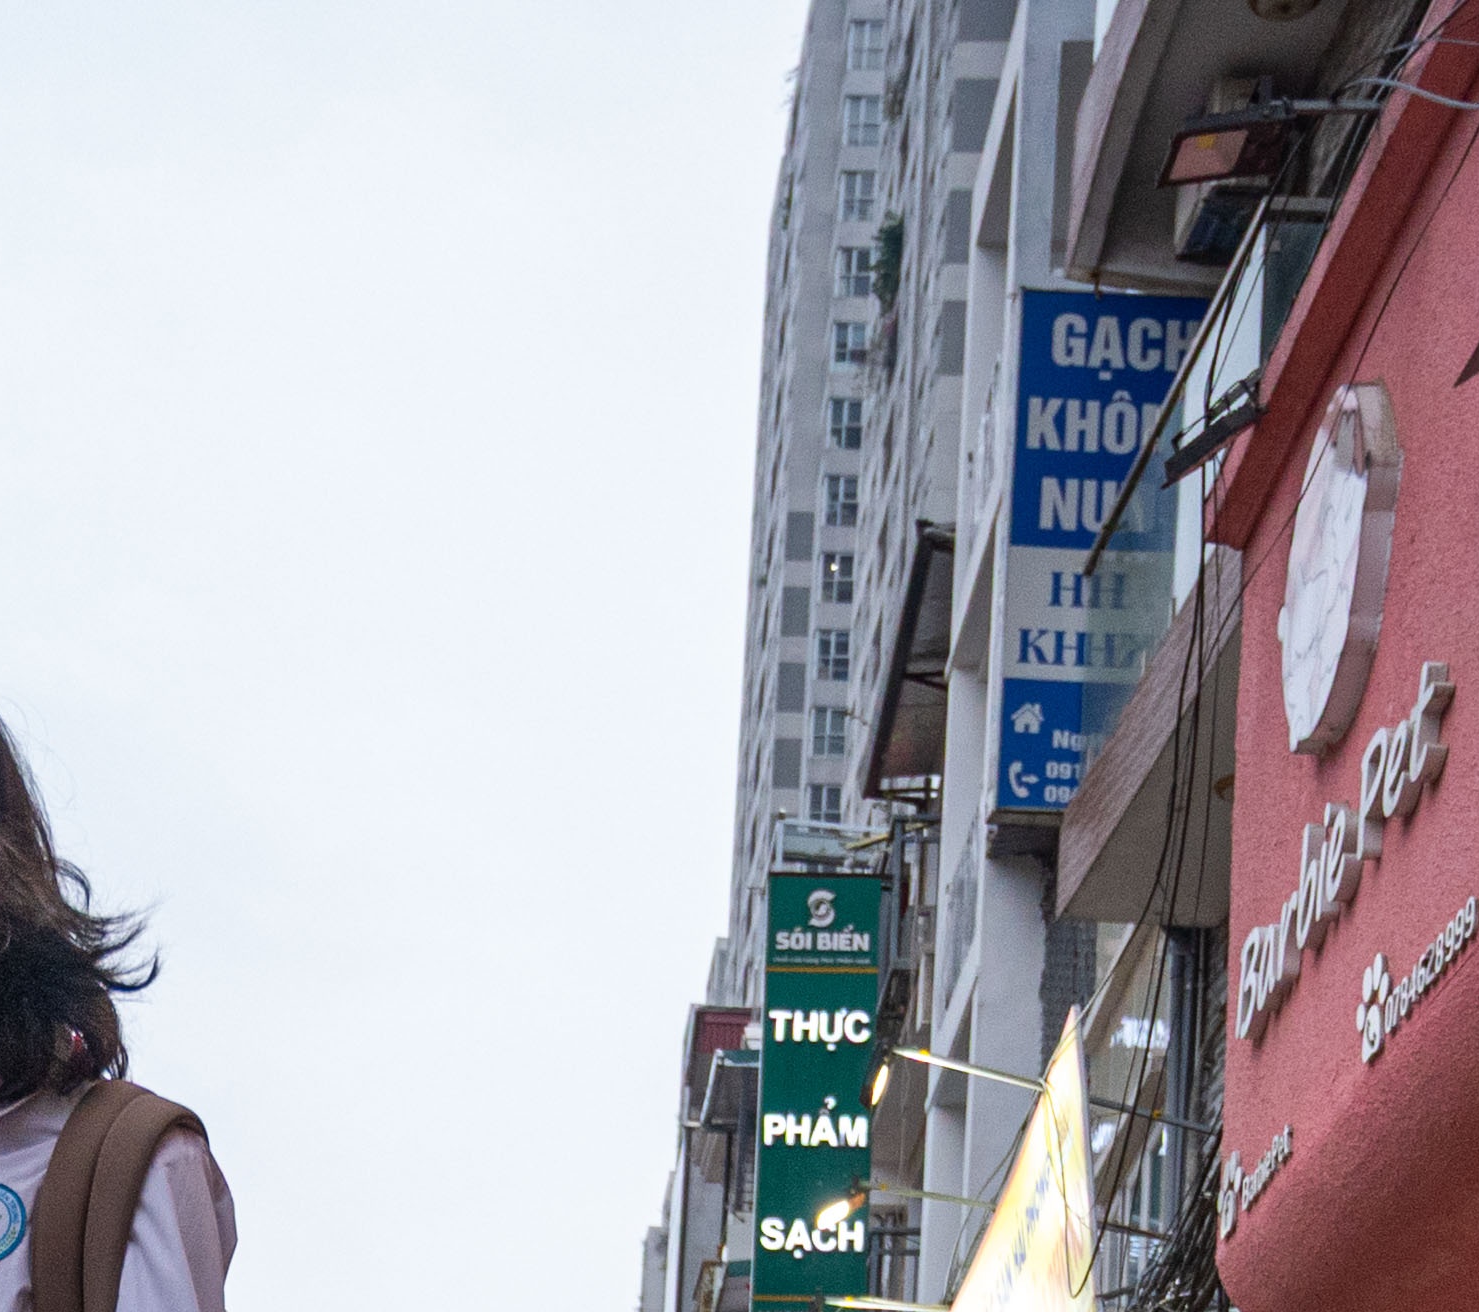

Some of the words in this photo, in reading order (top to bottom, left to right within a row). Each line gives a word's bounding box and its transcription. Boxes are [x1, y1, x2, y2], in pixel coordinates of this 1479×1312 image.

[1236, 809, 1347, 1039] Barbie
[1357, 663, 1442, 858] Pet
[775, 926, 812, 951] SÓI
[816, 923, 870, 952] BIỂN
[1383, 896, 1477, 1034] 0784628999
[768, 1008, 871, 1051] THỰC
[759, 1217, 865, 1260] SẠCH
